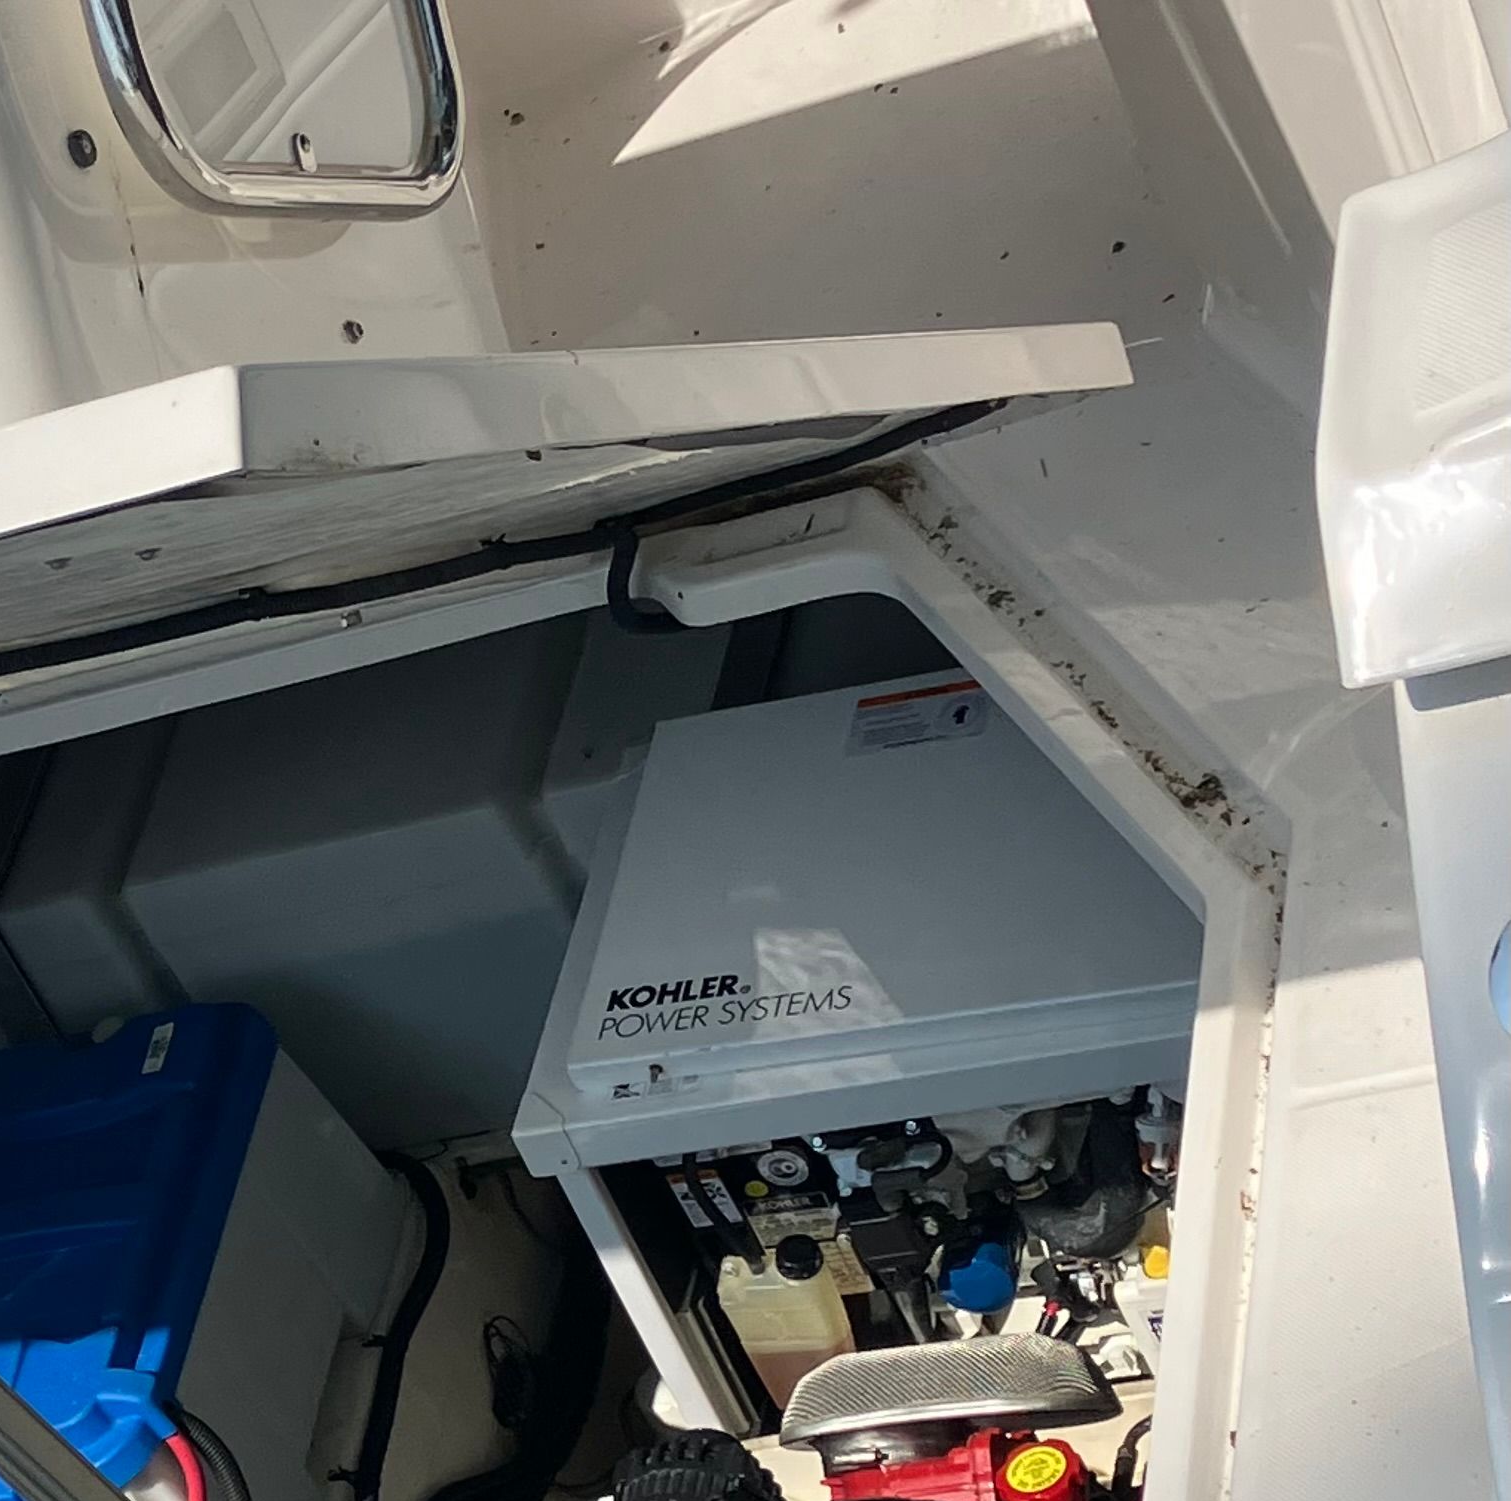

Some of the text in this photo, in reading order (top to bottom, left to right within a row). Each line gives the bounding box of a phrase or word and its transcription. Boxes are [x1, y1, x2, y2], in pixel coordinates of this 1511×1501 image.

[597, 985, 853, 1041] POWER SYSTEMS
[605, 974, 739, 1012] KOHLER
